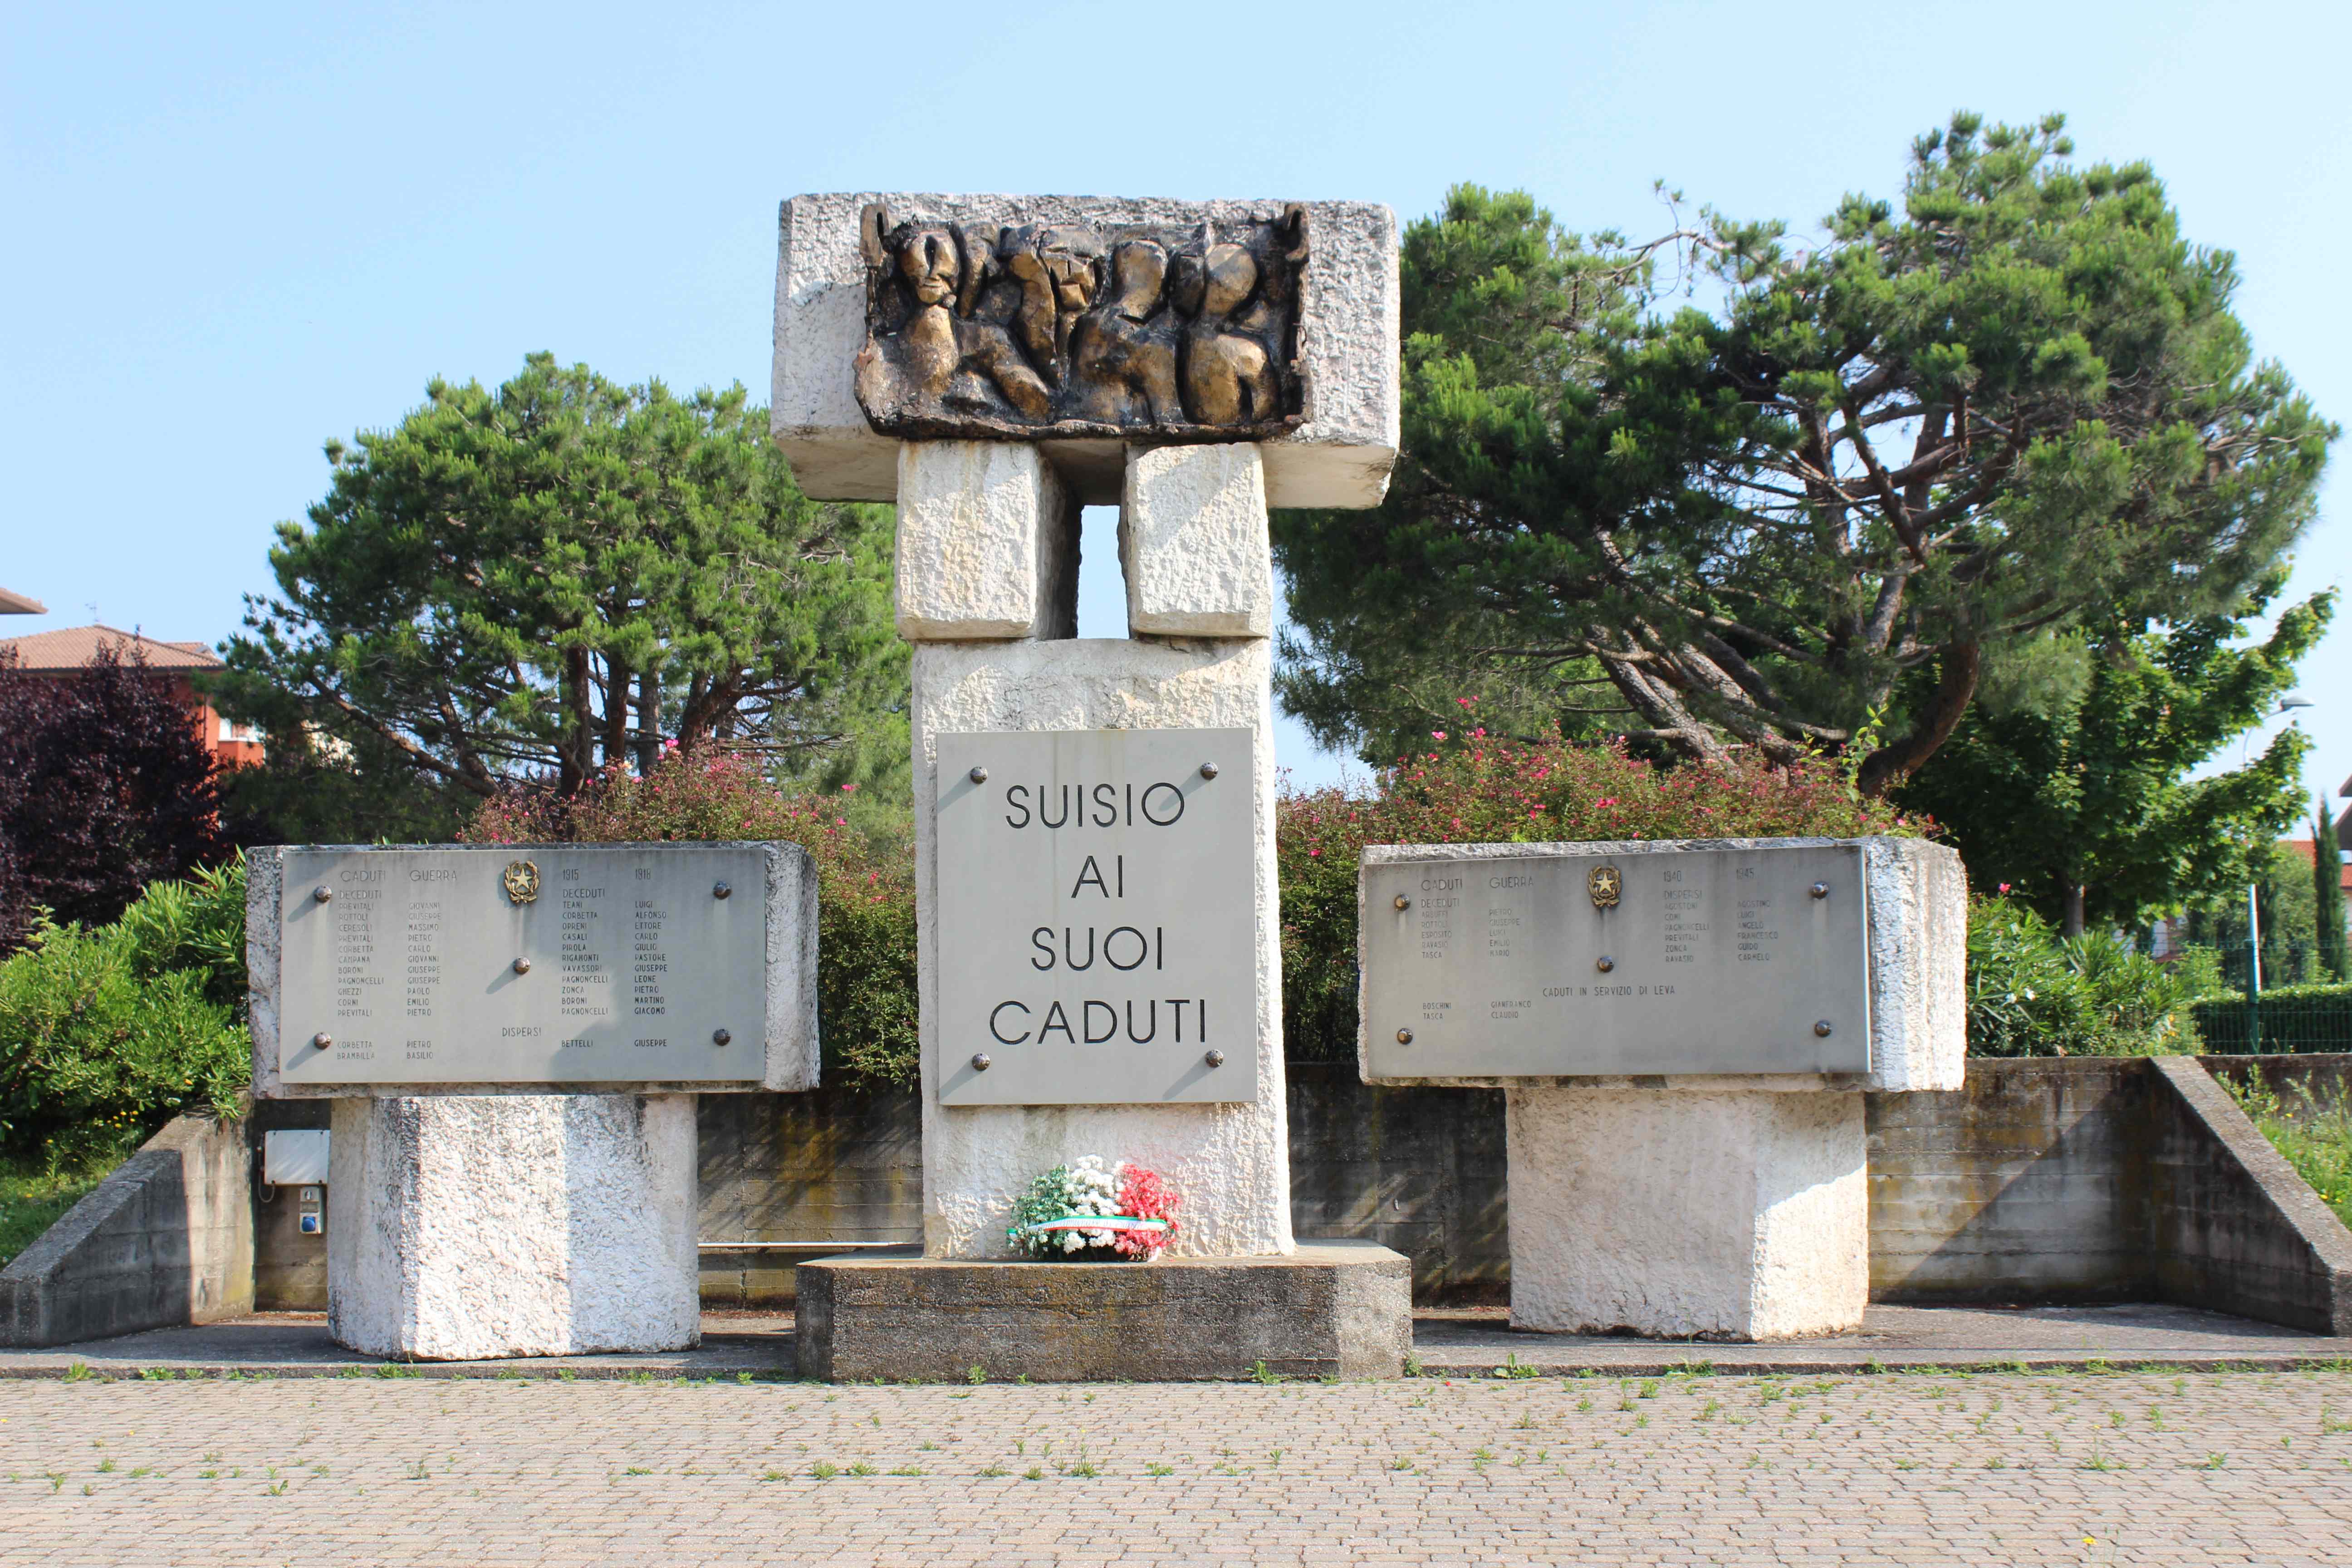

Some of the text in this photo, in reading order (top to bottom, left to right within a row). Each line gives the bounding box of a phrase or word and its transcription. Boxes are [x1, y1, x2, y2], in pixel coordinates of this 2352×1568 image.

[1005, 782, 1185, 828] SUISIO
[341, 870, 458, 882] CADUTI GUERRA
[563, 868, 651, 881] 1915 1918
[1071, 855, 1123, 898] AI
[1663, 867, 1754, 882] 1940 1945
[1421, 876, 1534, 891] CADUTI GUERRA
[339, 890, 382, 899] DECEDUTI
[563, 888, 605, 898] DECEDUTI
[1664, 889, 1702, 900] DISPERSI
[1421, 897, 1460, 908] DECEDUTI
[1489, 908, 1513, 916] PIETRO
[1489, 918, 1521, 926] GIUSEPPE
[1737, 921, 1764, 929] ANGELO
[1421, 930, 1452, 939] ESPOSITO
[1665, 931, 1779, 942] PREVITALI FRANCESCO
[562, 943, 587, 951] PIROLA
[1031, 926, 1162, 970] SUOI
[1421, 939, 1510, 949] RAVASIO EMILIO
[1665, 944, 1687, 952] ZONCA
[408, 945, 431, 953] CARLO
[1490, 949, 1509, 957] MARIO
[338, 956, 371, 964] CAMPANA
[562, 953, 666, 962] RIGAMONTI PASTORE
[1666, 953, 1770, 963] RAVASIO CARMELO
[338, 976, 441, 985] PAGNONCELLI GIUSEPPE
[562, 975, 657, 983] PAGNONCELLI LEONE
[338, 988, 362, 996] GHEZZI
[562, 985, 659, 994] ZONCA PIETRO
[1542, 985, 1676, 997] CADUTI IN SERVIZIO DI LEVA
[1422, 1000, 1531, 1010] BOSCHINI GIANFRANCO
[561, 1006, 666, 1015] PAGNONCELLI GIACOMO
[1491, 1011, 1519, 1019] CLAUDIO
[990, 999, 1205, 1044] CADUTI
[502, 1027, 541, 1037] DISPERSI
[337, 1041, 372, 1049] CORBETTA
[561, 1039, 668, 1048] BETTELLI GIUSEPPE
[406, 1051, 433, 1059] BASILIO
